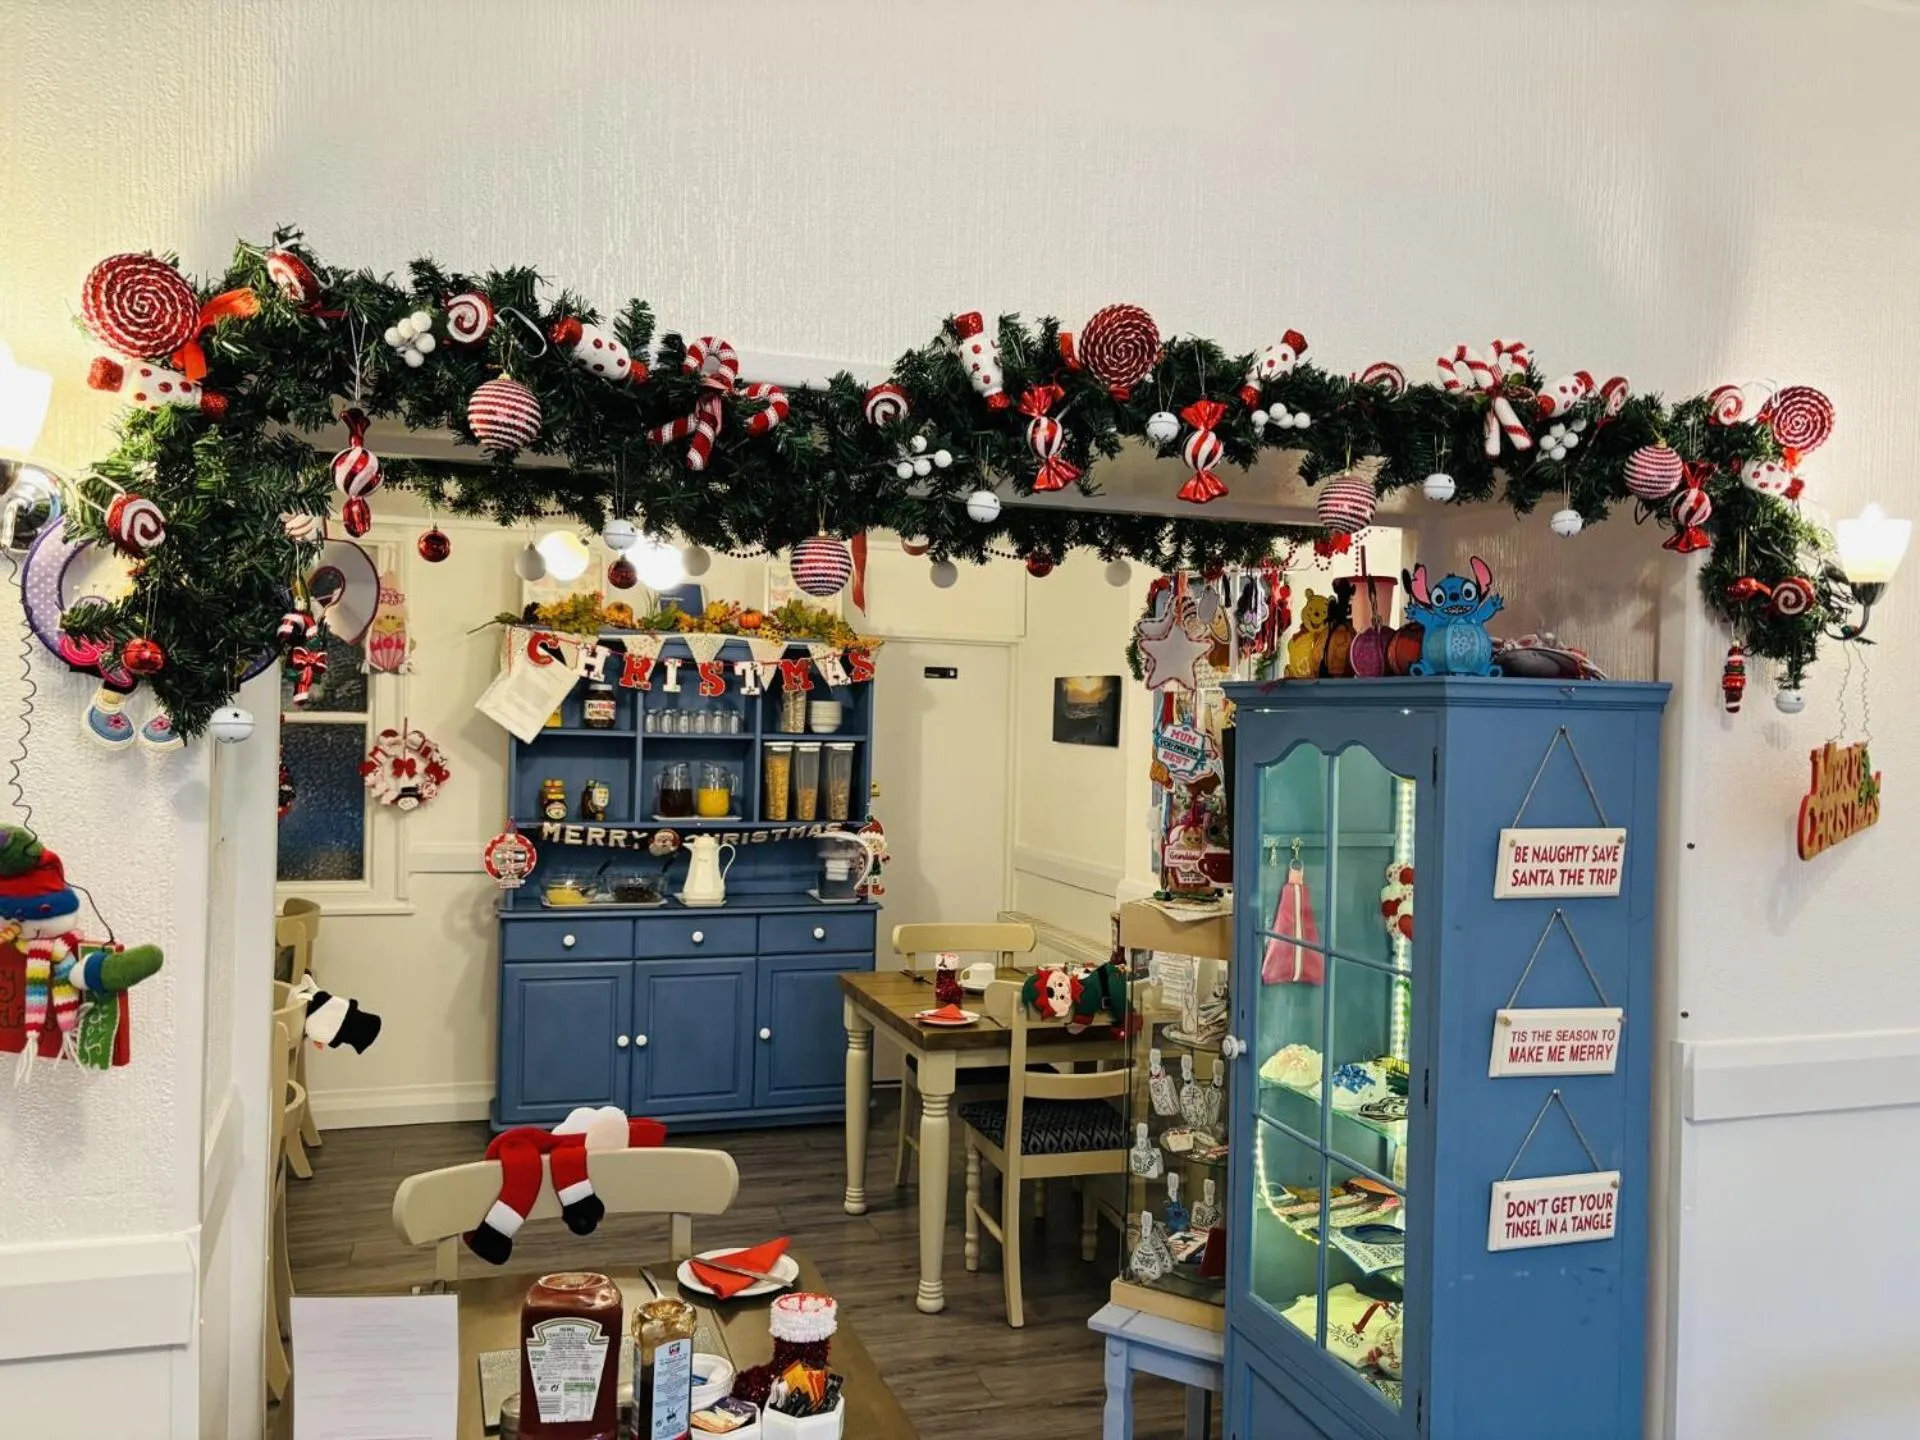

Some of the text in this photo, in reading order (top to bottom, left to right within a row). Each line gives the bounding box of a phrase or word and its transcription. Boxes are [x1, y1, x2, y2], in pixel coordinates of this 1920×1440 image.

[527, 630, 876, 698] CHRISTMAS
[1170, 729, 1197, 745] MUM
[542, 821, 842, 850] MERRY RISTMAS
[1514, 845, 1620, 863] BE NAUGHTY SAVE
[1511, 868, 1618, 887] SANTA THE TRIP
[1511, 1029, 1616, 1043] TIS THE SEASON TO
[1509, 1044, 1613, 1063] MAKE ME MERRY
[1507, 1192, 1613, 1219] DON'T GET YOUR
[1505, 1212, 1612, 1239] TINSEL IN A TANGLE
